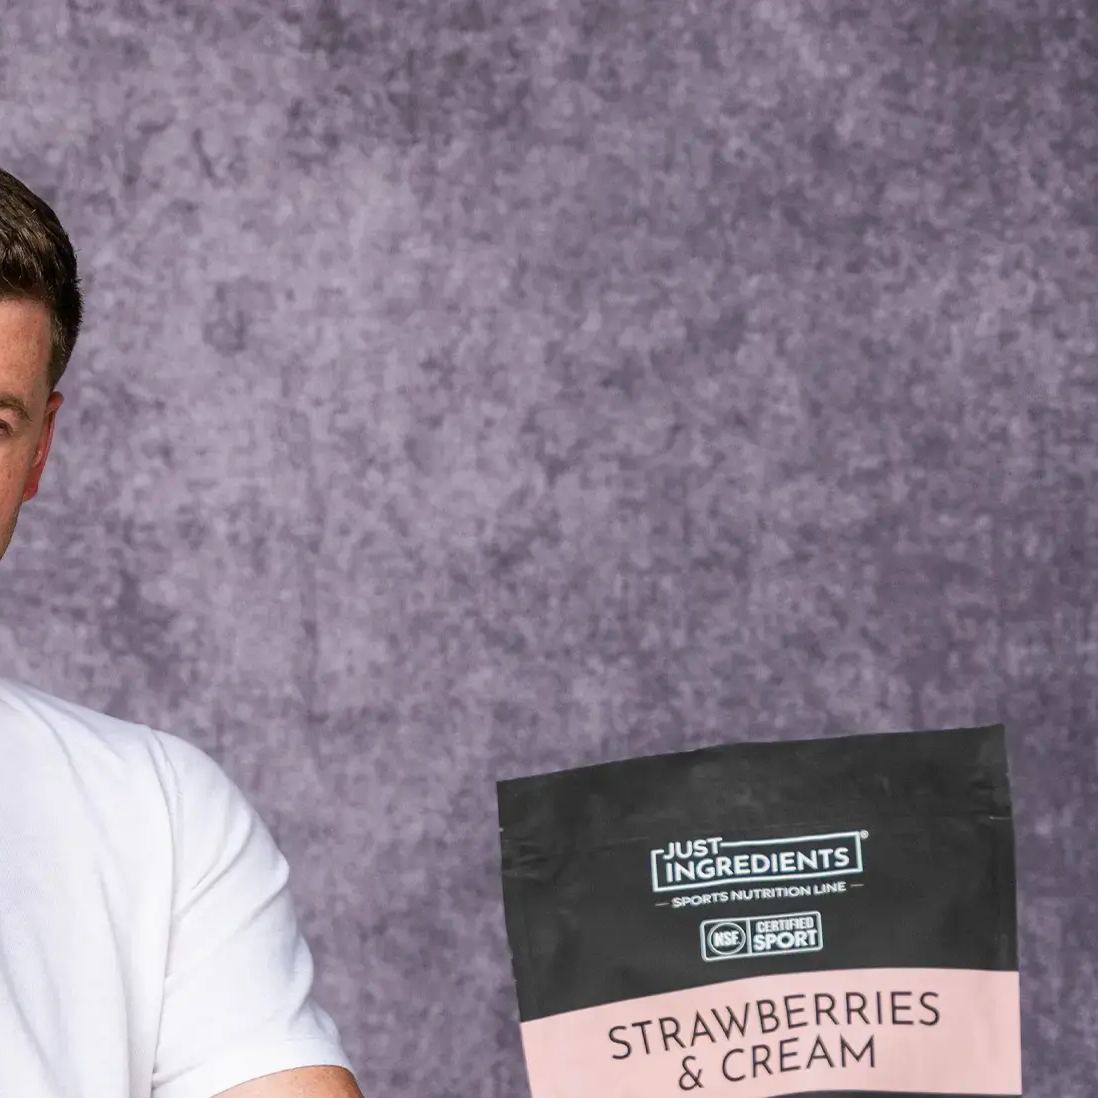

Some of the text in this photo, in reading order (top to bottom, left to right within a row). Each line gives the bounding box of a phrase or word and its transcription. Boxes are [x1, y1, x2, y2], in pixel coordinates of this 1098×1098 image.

[662, 837, 723, 860] JUST
[665, 847, 850, 883] INGREDIENTS
[671, 881, 847, 909] SPORTS NUTRITION LINE
[755, 916, 814, 933] CERTIFIED
[753, 930, 818, 951] SPORT
[607, 991, 942, 1060] STRAWBERRIES
[678, 1035, 876, 1091] & CREAM
